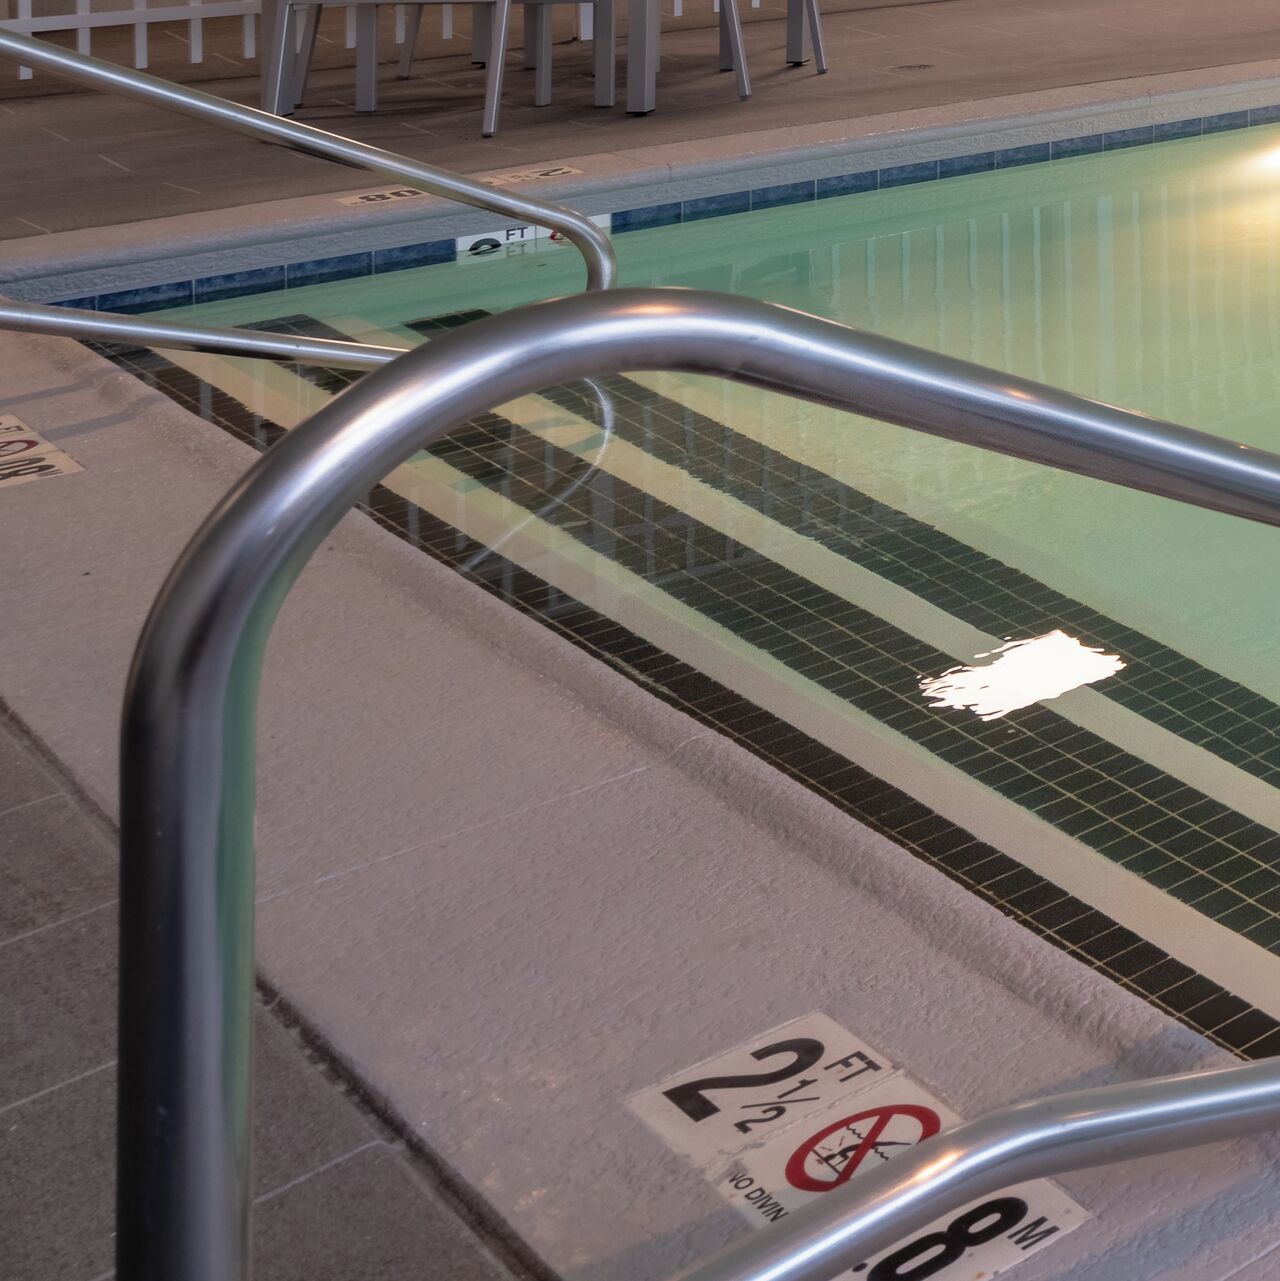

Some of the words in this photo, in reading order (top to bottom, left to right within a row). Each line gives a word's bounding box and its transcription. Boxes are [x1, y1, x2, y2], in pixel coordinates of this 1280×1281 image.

[505, 226, 528, 241] FT
[662, 1037, 826, 1123] 2
[823, 1050, 883, 1083] FT
[744, 1187, 790, 1222] DIVIN
[1007, 1216, 1060, 1251] M
